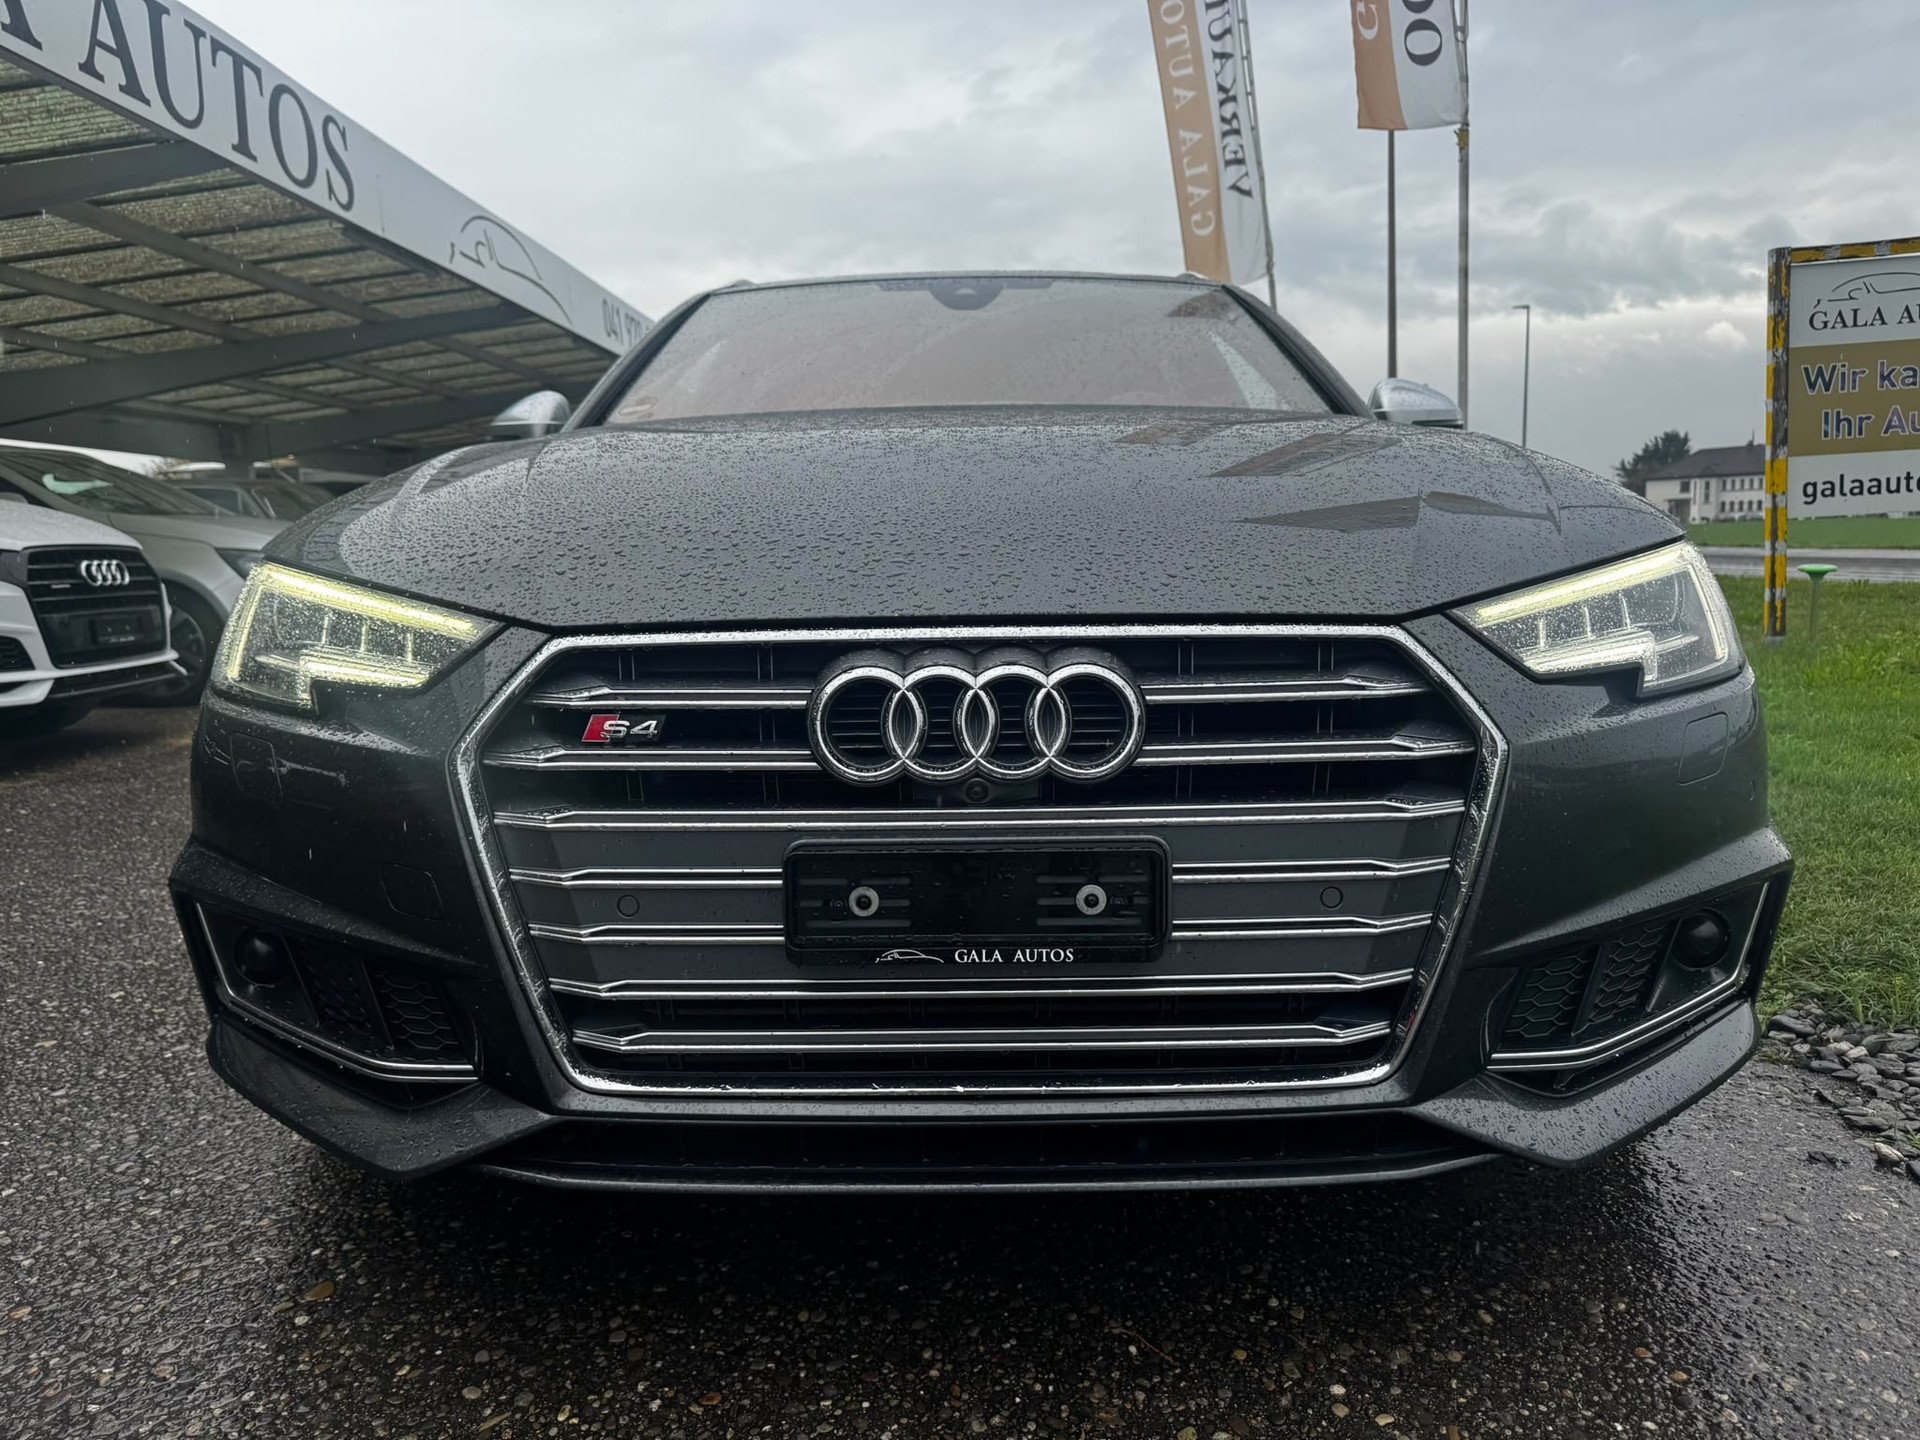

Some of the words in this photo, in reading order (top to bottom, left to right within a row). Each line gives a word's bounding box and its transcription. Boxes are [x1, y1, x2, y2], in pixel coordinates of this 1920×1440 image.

[78, 0, 354, 212] AUTOS
[1808, 305, 1889, 331] GALA
[1896, 303, 1920, 325] A
[1801, 361, 1869, 395] Wir
[1877, 358, 1919, 391] ka
[1821, 408, 1875, 440] Ihr
[600, 720, 658, 739] S4
[954, 948, 1004, 963] GALA
[1012, 948, 1075, 963] AUTOS
